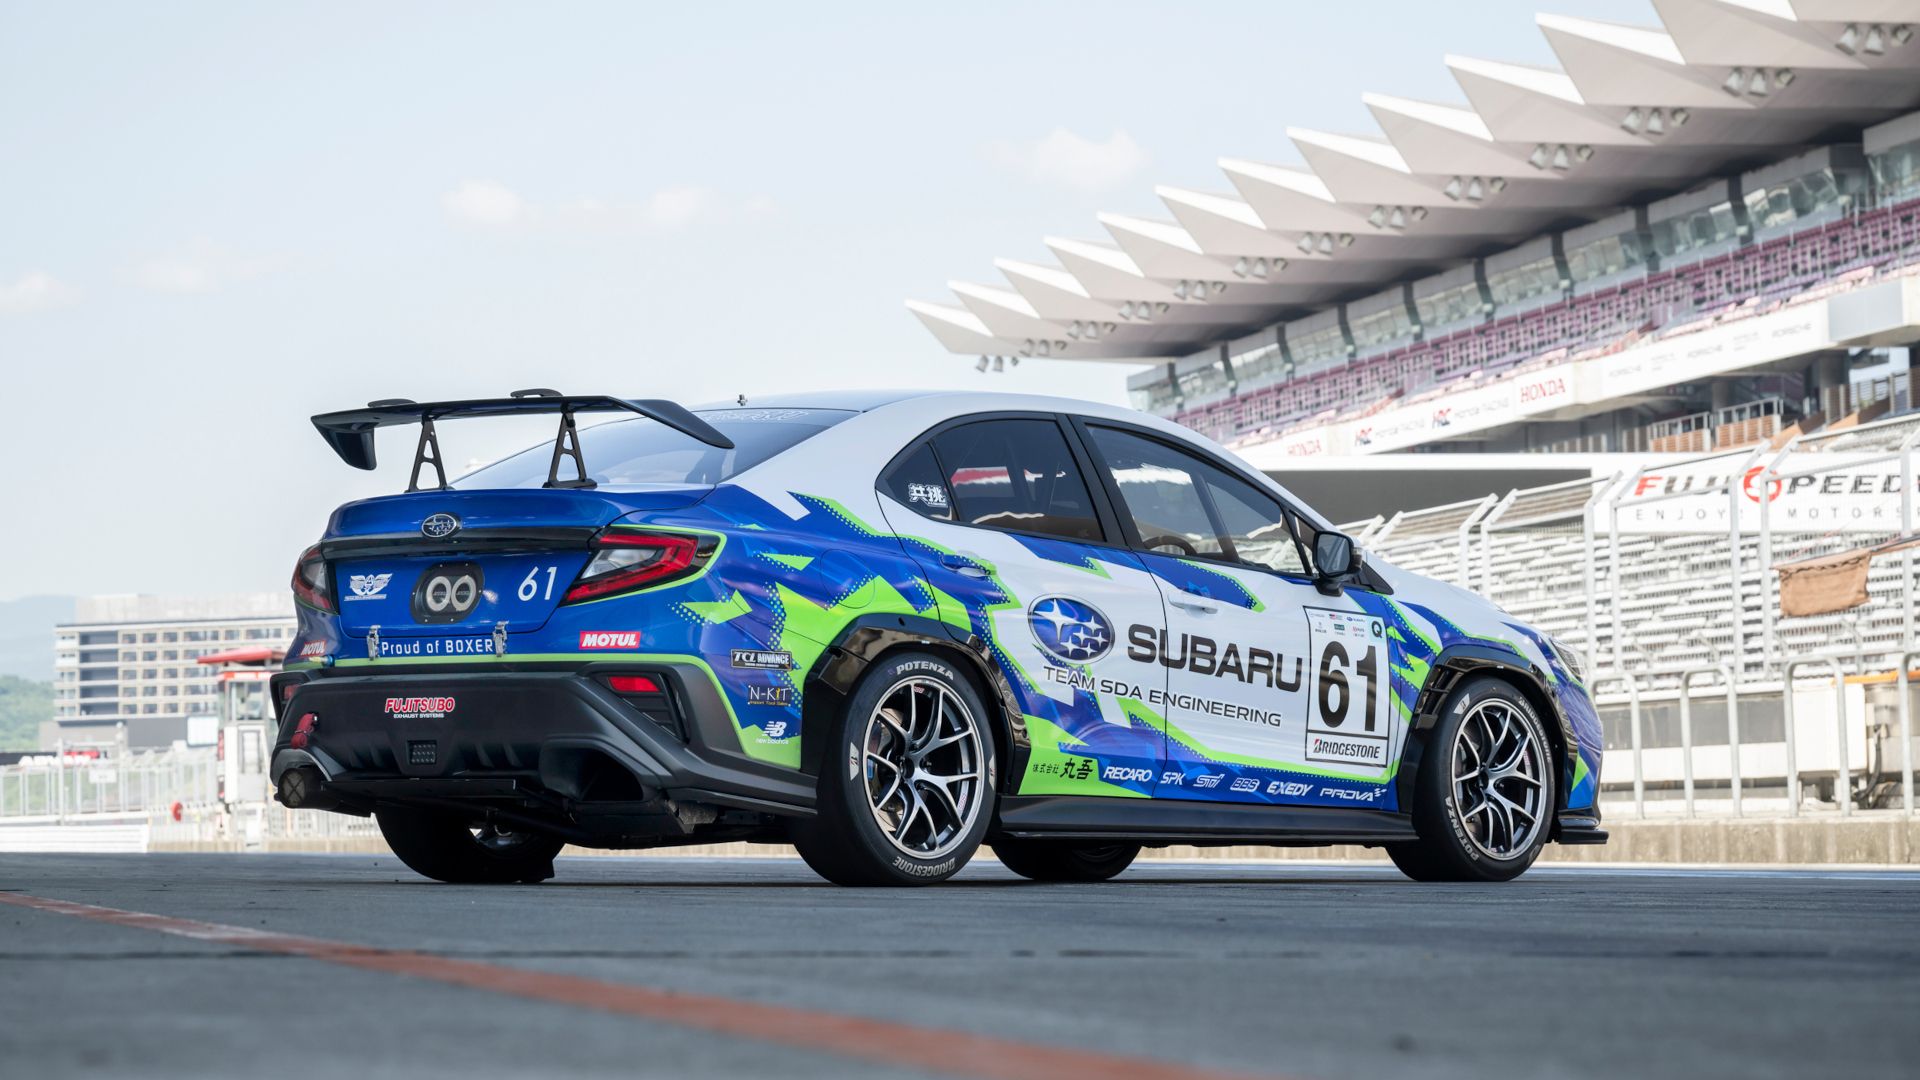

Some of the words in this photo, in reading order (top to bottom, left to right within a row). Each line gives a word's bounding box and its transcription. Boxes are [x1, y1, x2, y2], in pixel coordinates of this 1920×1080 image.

[1521, 378, 1567, 404] HONDA
[1287, 440, 1321, 456] HONDA
[518, 566, 557, 601] 61
[1371, 620, 1382, 638] Q
[381, 641, 420, 654] Proud
[427, 641, 439, 654] of
[446, 639, 493, 654] BOXER
[582, 633, 637, 647] MOTUL
[301, 642, 325, 655] MOTUL
[757, 653, 790, 664] ADVANCE
[1127, 623, 1303, 693] SUBARU
[896, 661, 954, 681] POTENZA
[1318, 641, 1376, 732] 61
[1043, 665, 1095, 690] TEAM
[1100, 679, 1143, 700] SDA
[1148, 689, 1282, 728] ENGINEERING
[385, 697, 455, 713] FUJITSUBO
[1313, 739, 1380, 759] BRIDGESTONE
[1103, 766, 1153, 782] RECARO
[1160, 771, 1185, 785] SPK
[1230, 777, 1261, 793] BBS
[1266, 781, 1314, 797] EXEDY
[1320, 787, 1376, 802] PROVA
[1445, 796, 1479, 861] POTENZA
[892, 856, 956, 877] BRIDGESTONE
